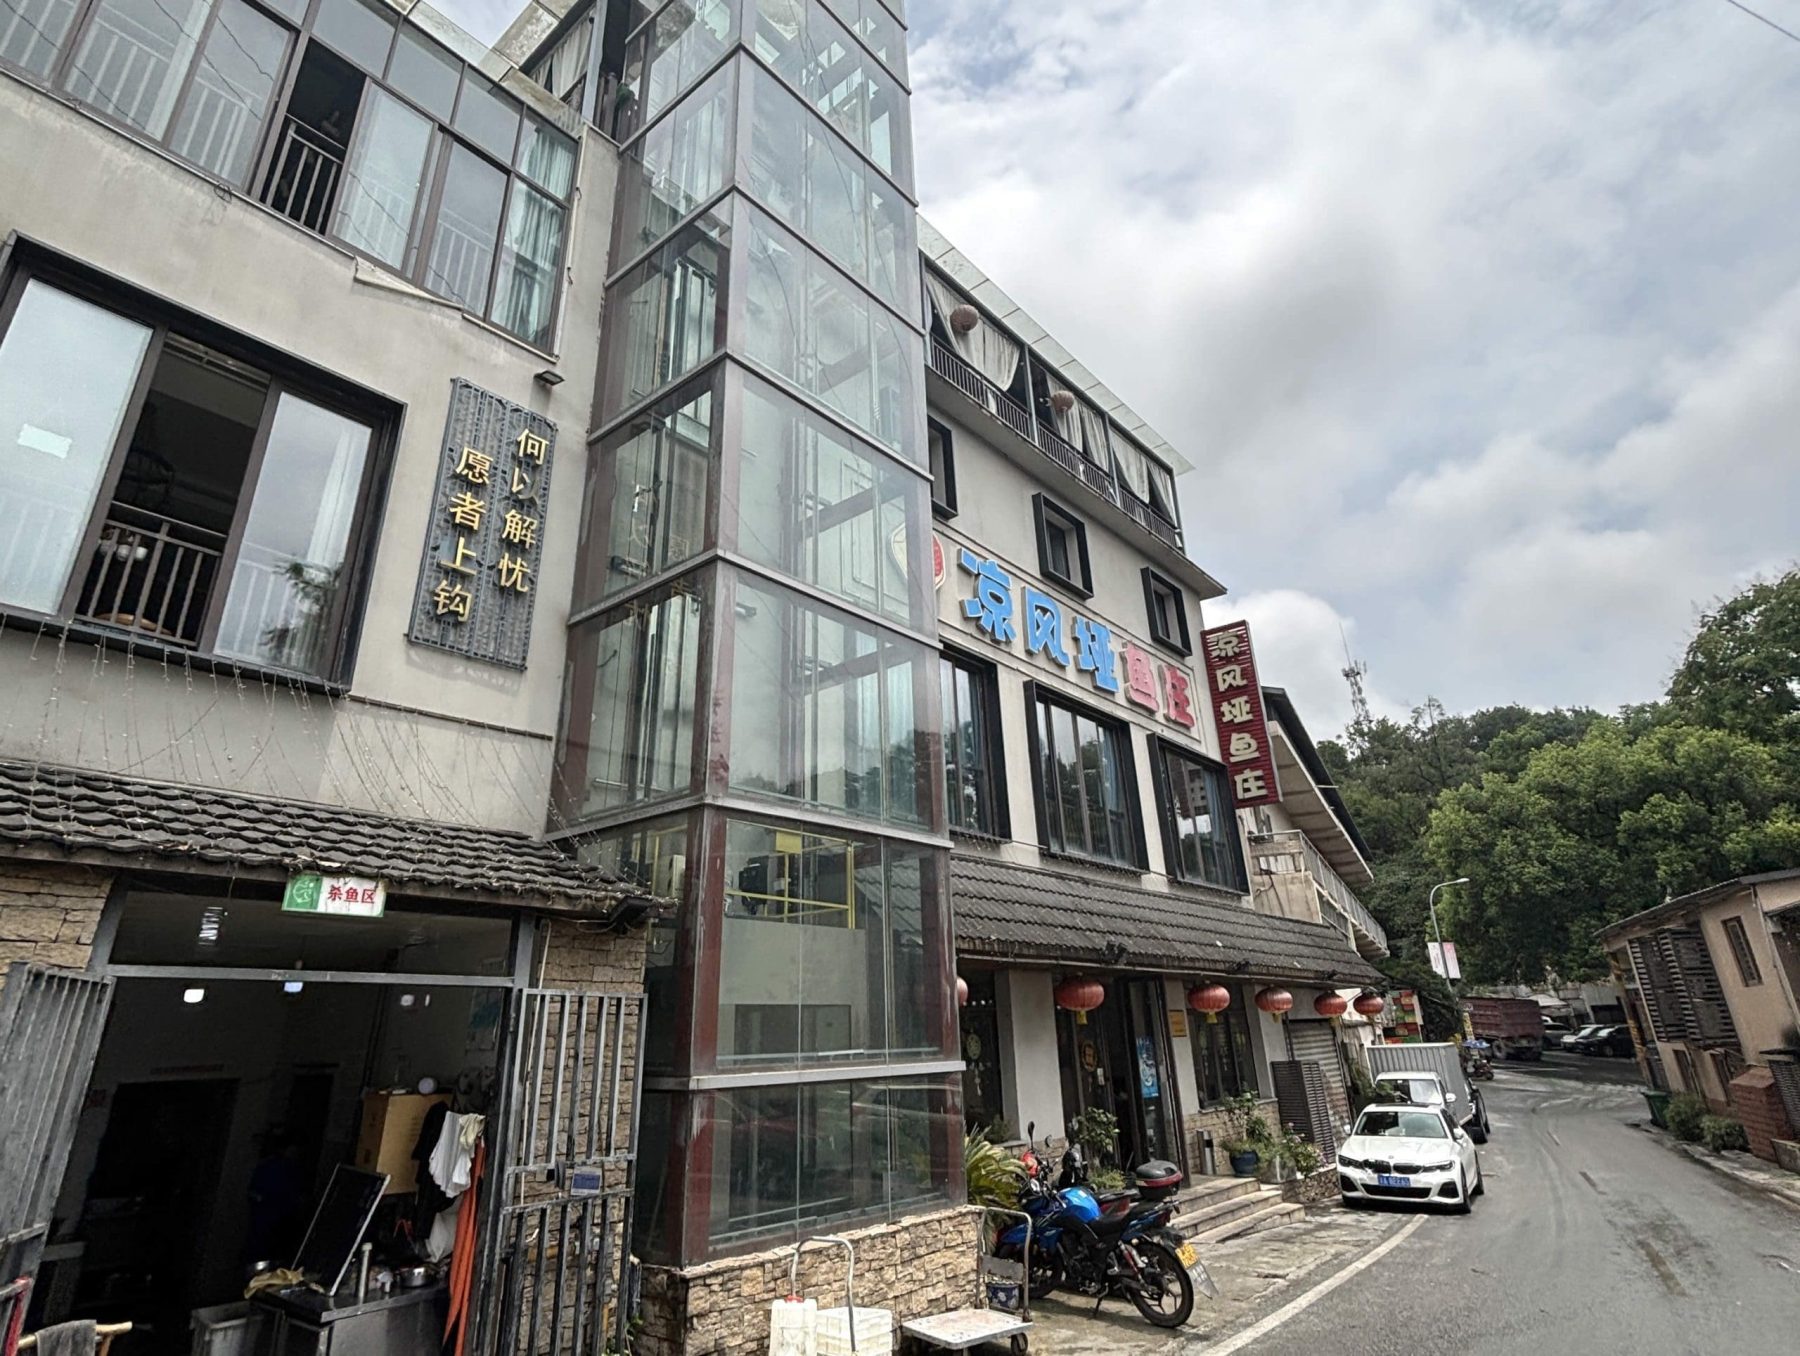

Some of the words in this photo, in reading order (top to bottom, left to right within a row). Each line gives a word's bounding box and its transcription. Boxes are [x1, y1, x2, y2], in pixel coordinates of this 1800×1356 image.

[433, 447, 493, 623] 愿者上钩
[498, 428, 549, 593] 何以解忧
[957, 548, 1195, 729] 凉风垭鱼庄
[1209, 631, 1268, 800] 凉风垭鱼庄
[327, 884, 375, 904] 杀鱼区
